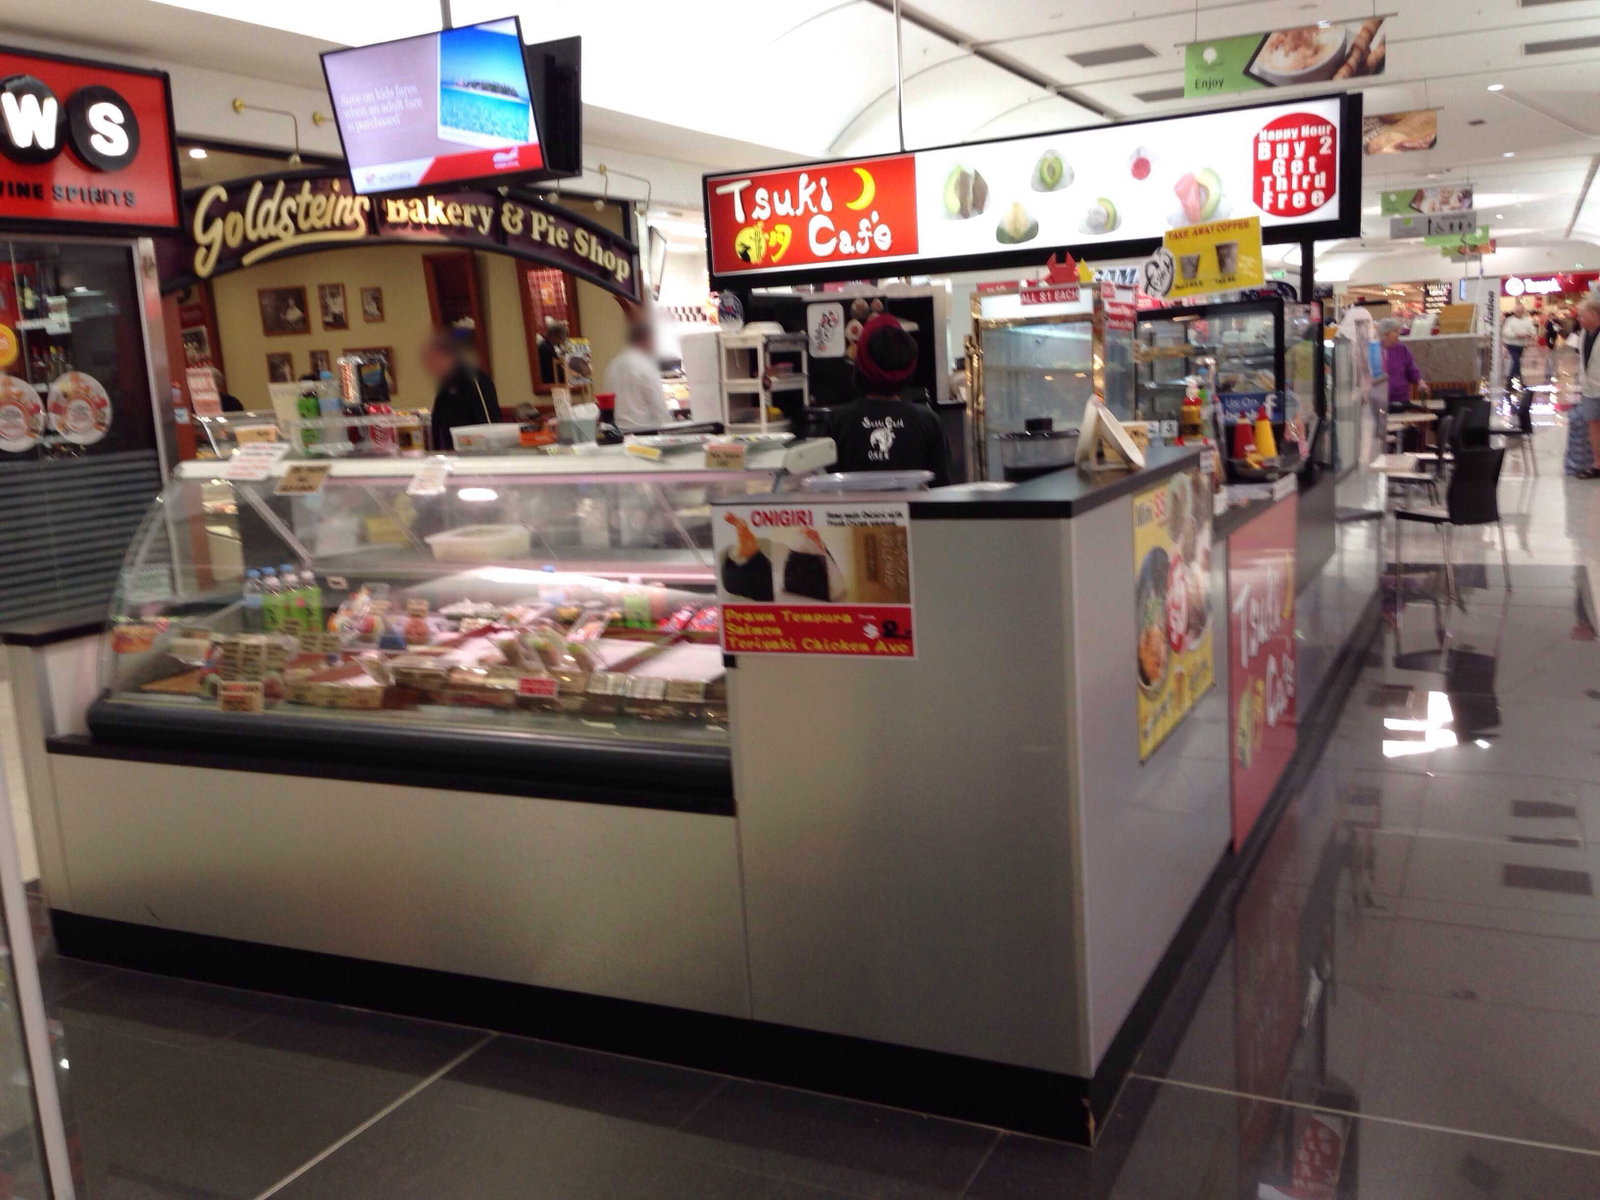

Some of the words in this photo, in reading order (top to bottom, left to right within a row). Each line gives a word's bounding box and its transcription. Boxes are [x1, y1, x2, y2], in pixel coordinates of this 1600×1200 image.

[1194, 78, 1225, 90] Enjoy
[340, 92, 363, 106] Save
[375, 86, 395, 100] kids
[395, 84, 417, 98] fares
[380, 98, 404, 114] adult
[404, 96, 423, 111] fare
[355, 114, 400, 133] purchased
[1259, 128, 1298, 142] Happy
[1301, 124, 1332, 138] Hour
[1258, 140, 1306, 161] Buy
[1319, 135, 1333, 155] 2
[1272, 156, 1317, 177] Get
[1261, 171, 1327, 192] Third
[53, 184, 137, 207] SPIRITS
[716, 173, 833, 224] Tsuki
[1262, 190, 1325, 211] Free
[386, 194, 494, 236] Bakery
[501, 201, 524, 235] &
[529, 209, 570, 250] Pie
[573, 227, 630, 283] Shop
[1168, 229, 1189, 240] TAKE
[1192, 224, 1215, 237] AWAY
[1216, 220, 1250, 232] COFFEE
[1021, 292, 1038, 304] ALL
[1040, 290, 1052, 303] $1
[1054, 288, 1079, 302] EACH
[750, 509, 815, 528] ONIGIRI
[723, 608, 776, 624] Prawn
[780, 609, 854, 625] Tempura
[725, 622, 784, 637] Salmon
[727, 636, 796, 651] Teriyaki
[801, 637, 870, 653] Chicken
[874, 640, 910, 654] Avo
